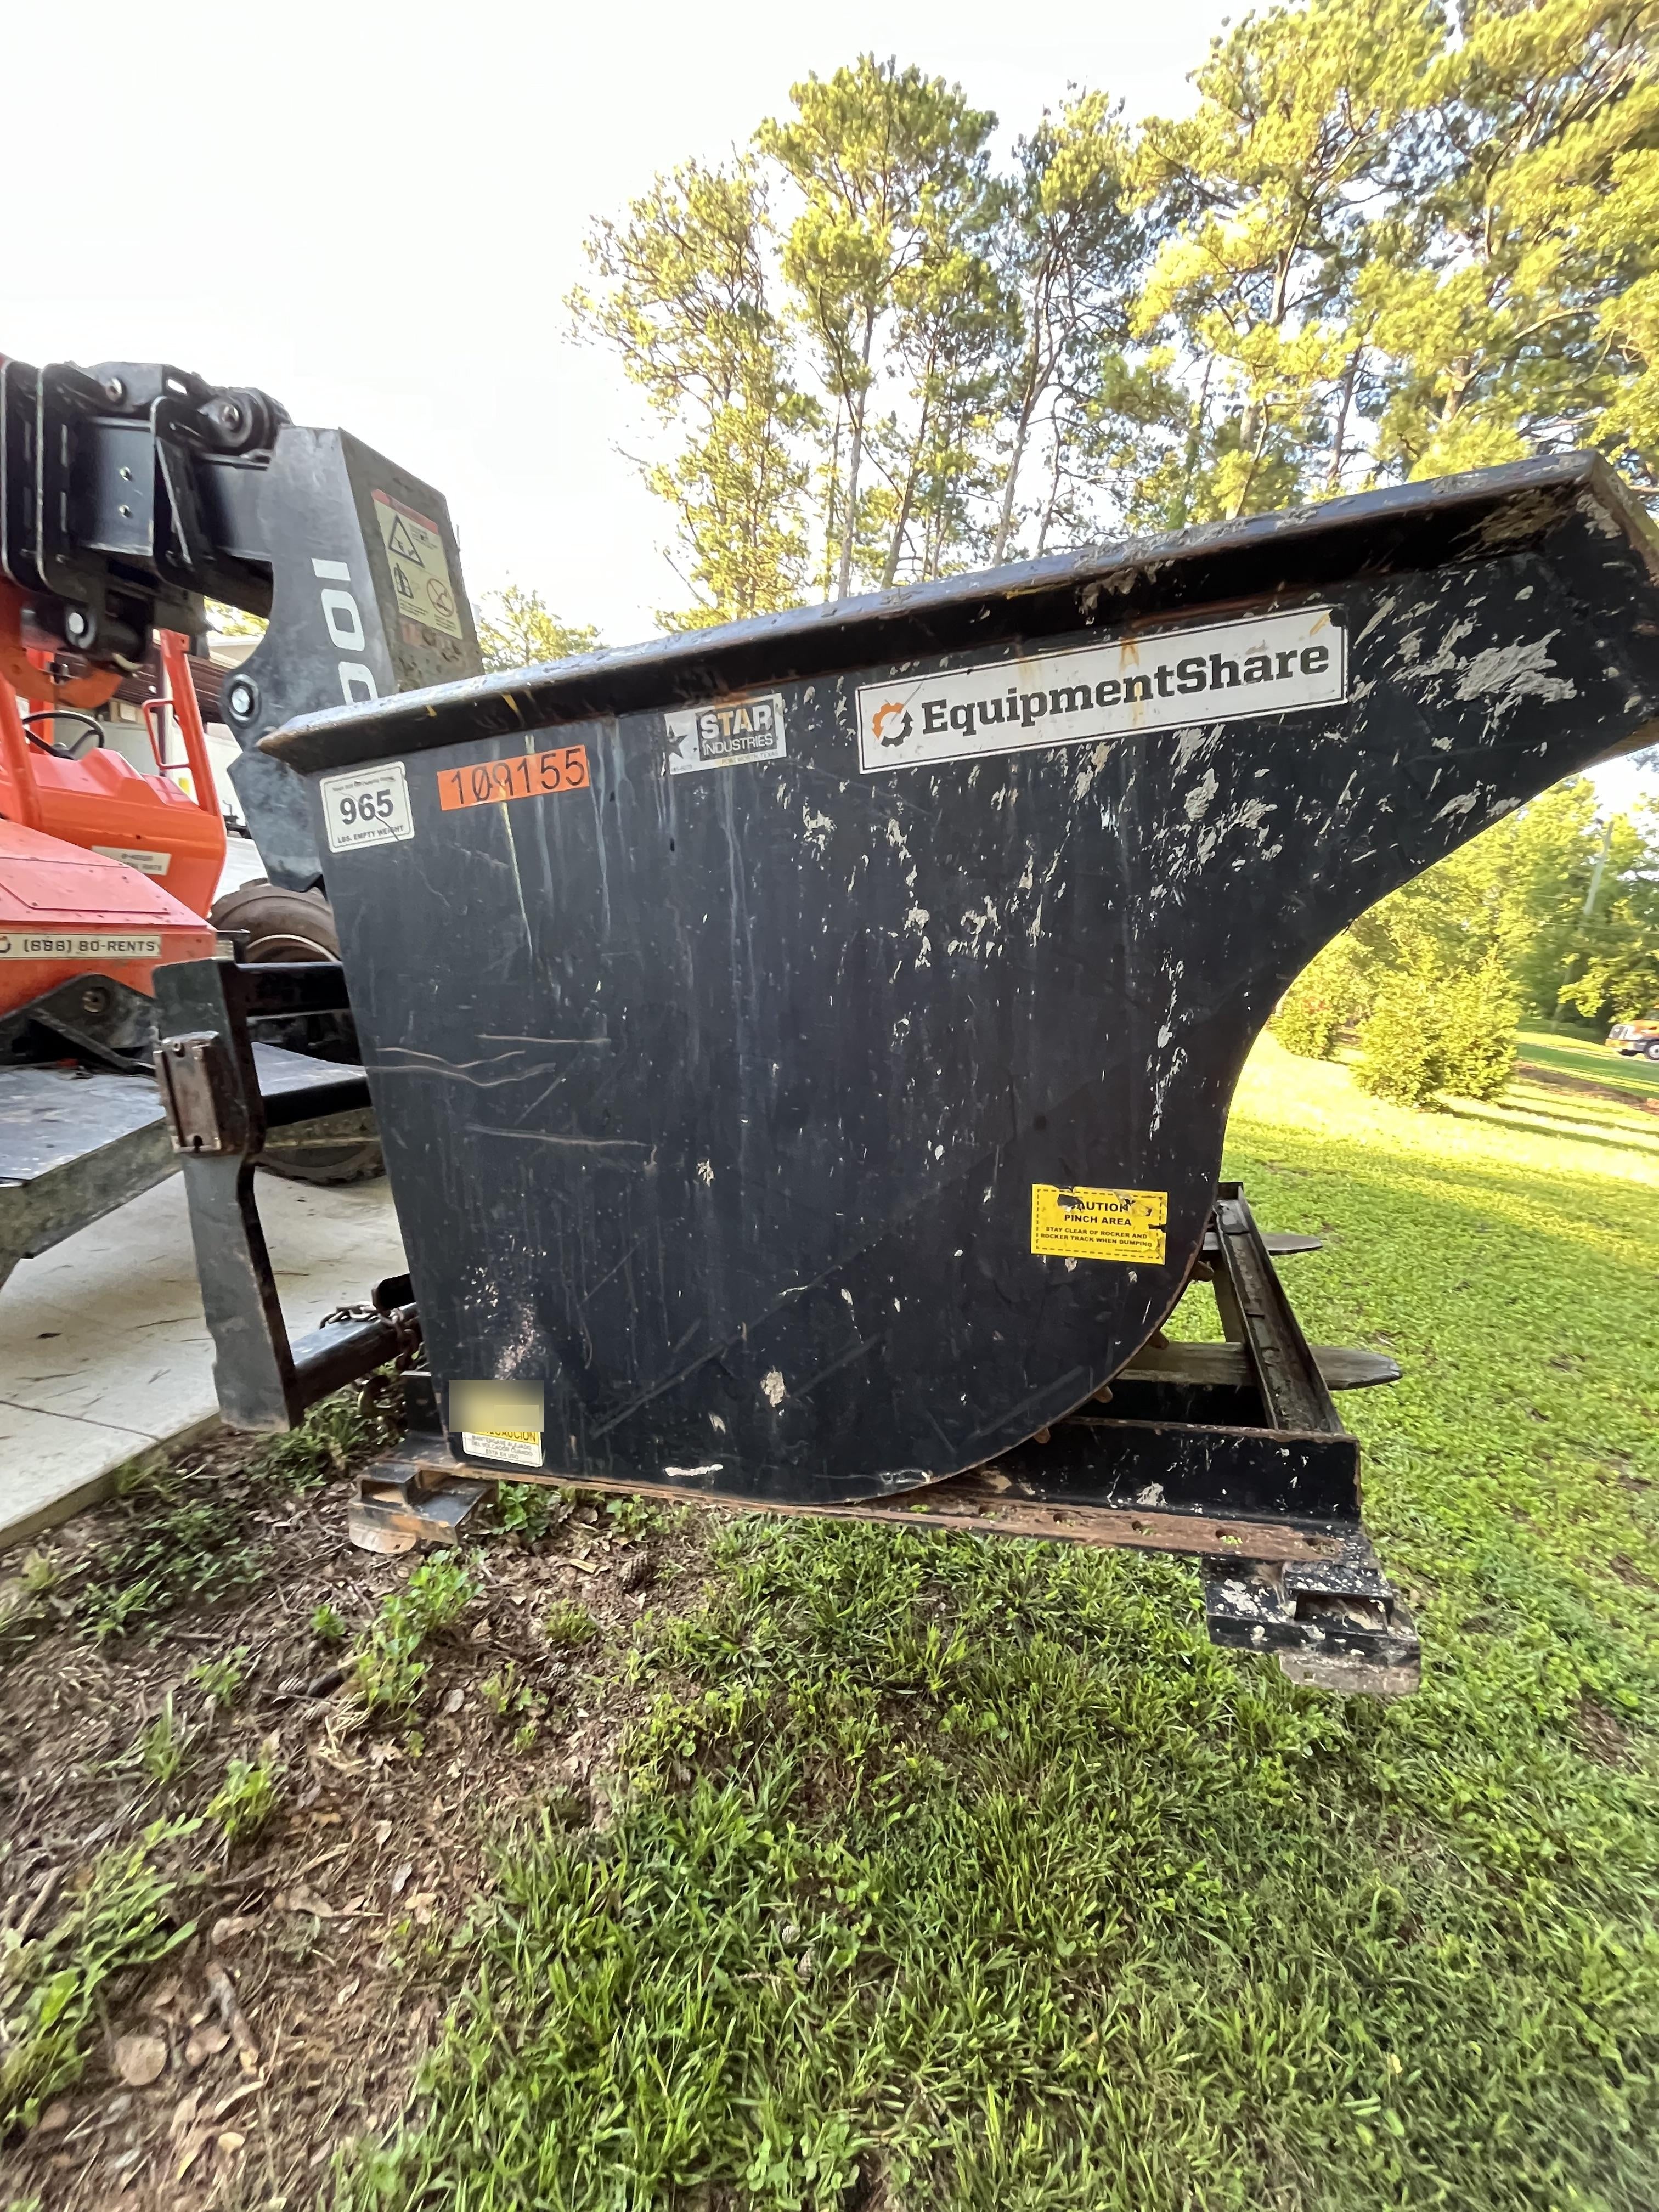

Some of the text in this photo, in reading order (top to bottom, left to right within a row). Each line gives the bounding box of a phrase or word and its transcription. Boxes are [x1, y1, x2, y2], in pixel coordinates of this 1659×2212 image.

[921, 645, 1329, 735] EquipmentShare
[700, 705, 774, 739] STAR
[702, 733, 774, 755] INDUSTRIES
[451, 748, 585, 804] 109155
[340, 789, 393, 825] 965
[354, 831, 375, 840] EMPTY
[377, 825, 404, 836] WEIGHT
[79, 940, 155, 952] 80-RENTS
[1072, 1200, 1129, 1212] AUTION
[1064, 1214, 1131, 1226] PINCH AREA
[1119, 1239, 1152, 1248] DUMPING
